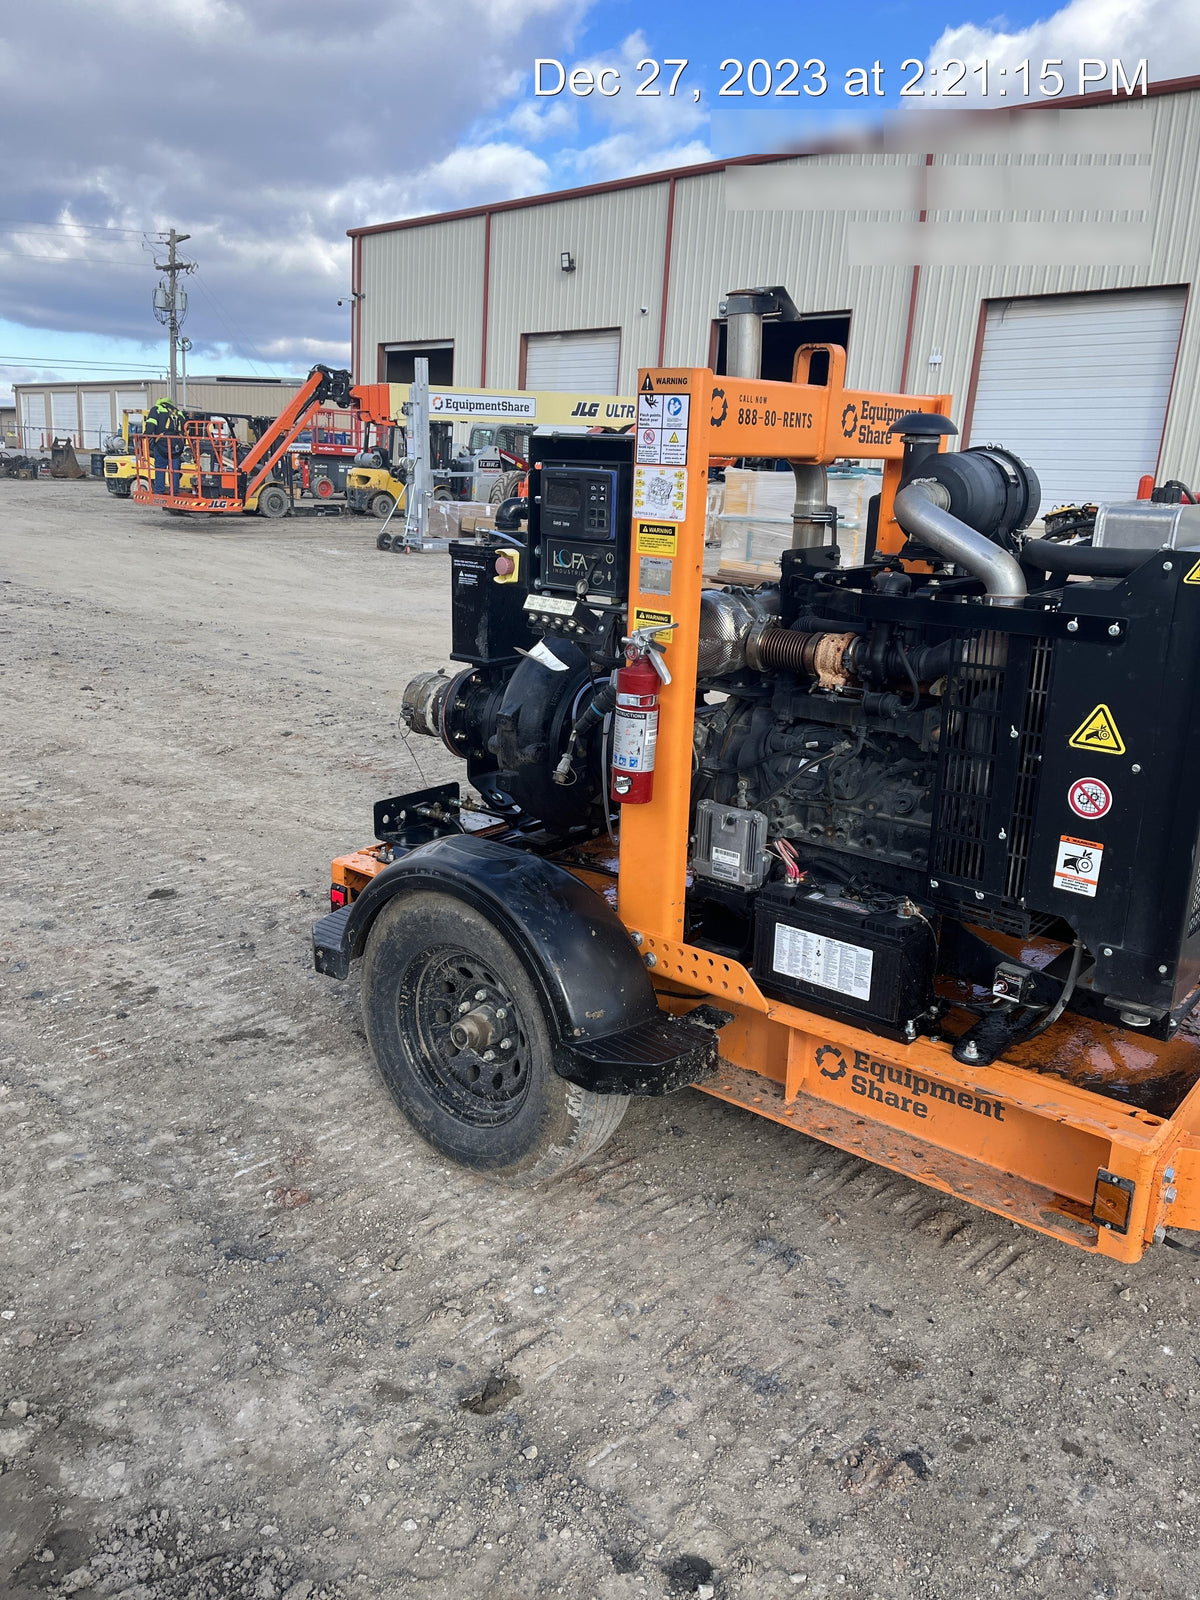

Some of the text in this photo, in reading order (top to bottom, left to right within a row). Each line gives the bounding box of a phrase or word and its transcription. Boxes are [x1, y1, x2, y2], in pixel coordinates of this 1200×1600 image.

[656, 377, 688, 385] WARNING
[445, 398, 530, 413] EquipmentShare
[739, 394, 768, 405] CALL NOW
[570, 402, 637, 419] JLG ULTR
[737, 408, 813, 429] 888-80-RENTS
[860, 400, 923, 426] Equipm
[858, 424, 893, 445] Share
[208, 500, 227, 509] JLG
[648, 527, 673, 535] WARNING
[553, 549, 588, 571] LOFA
[552, 568, 587, 577] INDUSTRIE
[645, 614, 669, 622] WARNING
[853, 1050, 1006, 1122] Equipment
[851, 1074, 928, 1119] Share
